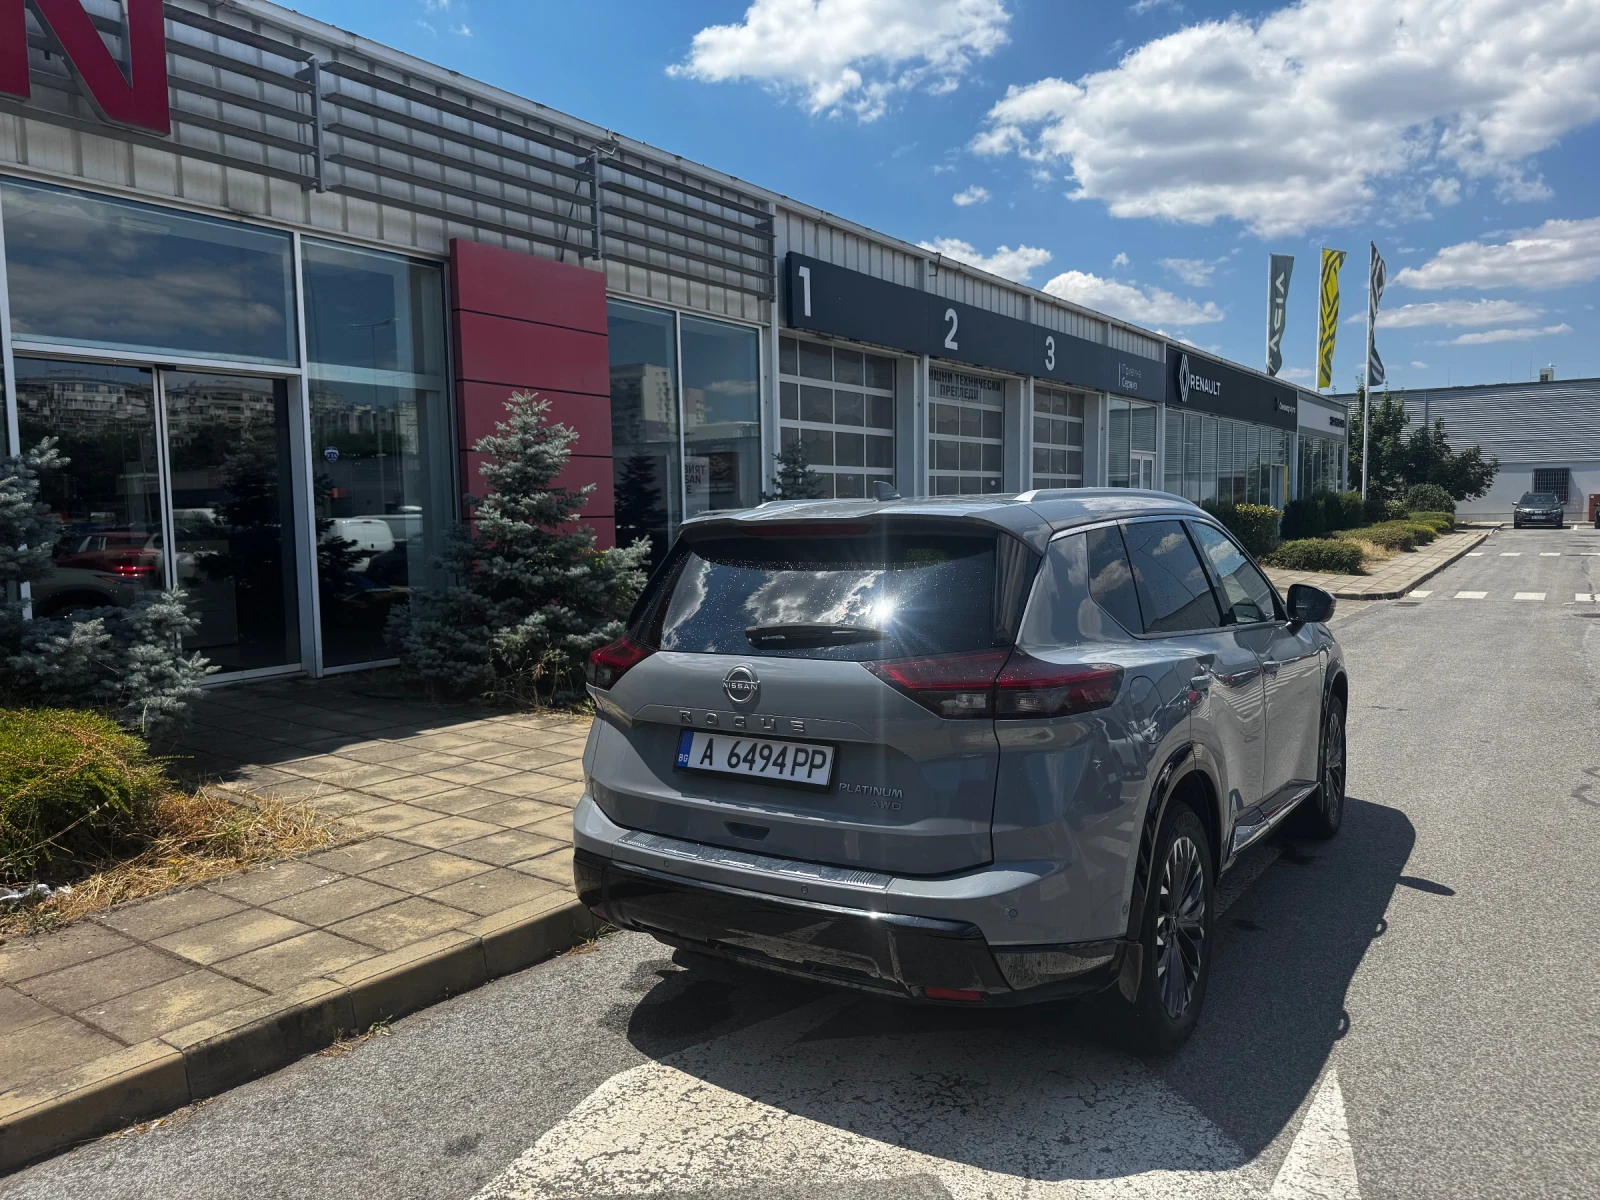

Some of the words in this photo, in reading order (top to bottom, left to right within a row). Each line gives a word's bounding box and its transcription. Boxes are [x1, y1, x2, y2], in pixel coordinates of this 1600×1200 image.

[798, 265, 812, 317] 1
[944, 308, 958, 351] 2
[1045, 335, 1056, 371] 3
[955, 374, 1000, 391] ТЕХНИЧЕСКИ
[1190, 374, 1221, 396] RENAULT
[940, 385, 978, 400] ПРЕГЛЕДИ
[722, 682, 758, 690] NISSAN
[679, 710, 805, 732] ROGUE
[678, 753, 689, 763] BG
[699, 737, 714, 767] A
[838, 782, 903, 798] PLATINUM
[869, 799, 903, 811] AWD
